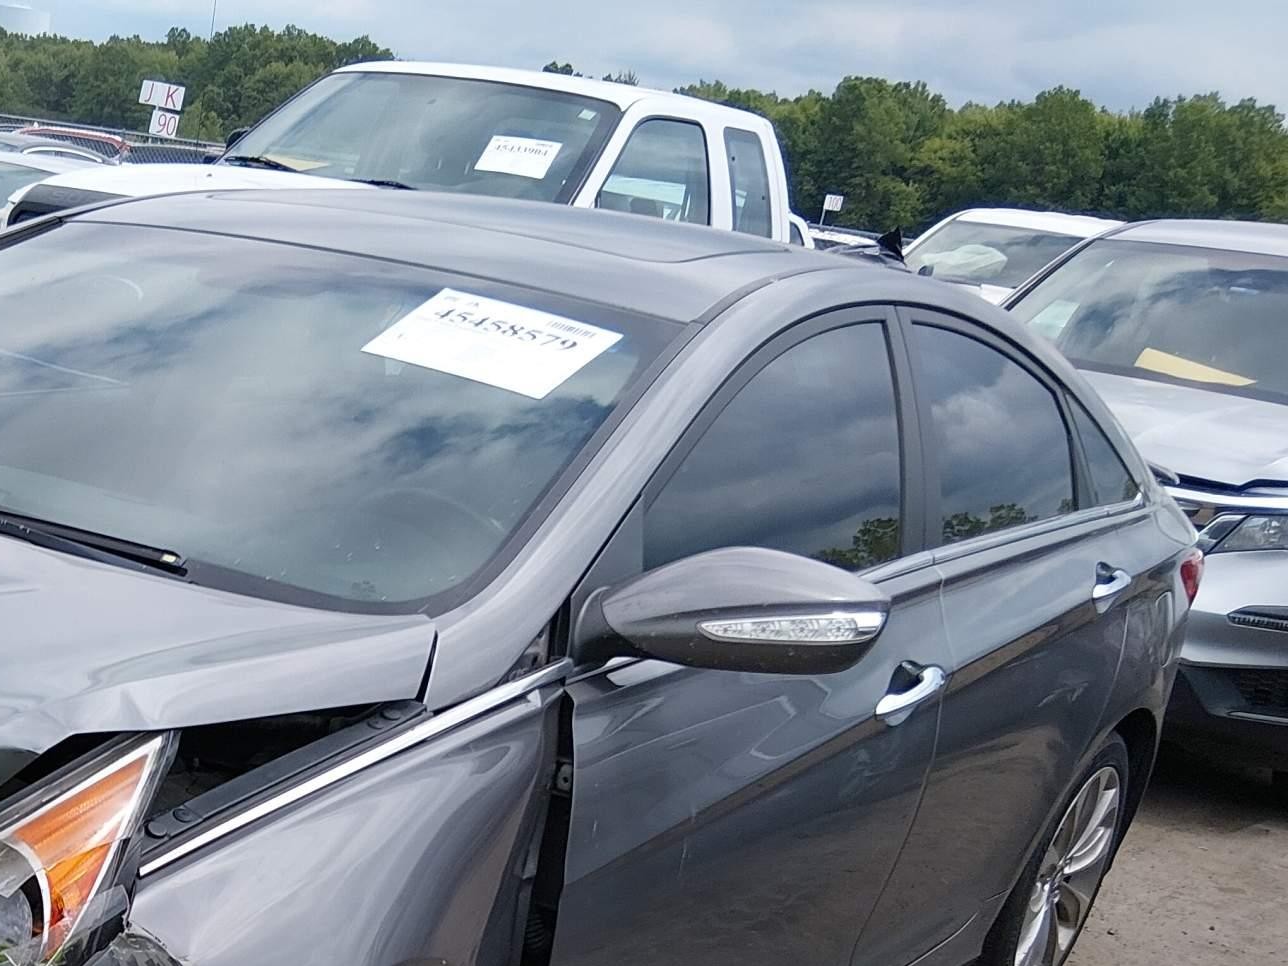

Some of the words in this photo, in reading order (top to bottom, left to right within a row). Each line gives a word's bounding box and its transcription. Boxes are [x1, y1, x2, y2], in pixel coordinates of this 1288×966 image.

[164, 86, 179, 108] K
[156, 113, 177, 136] 90
[433, 308, 578, 350] 45458579
